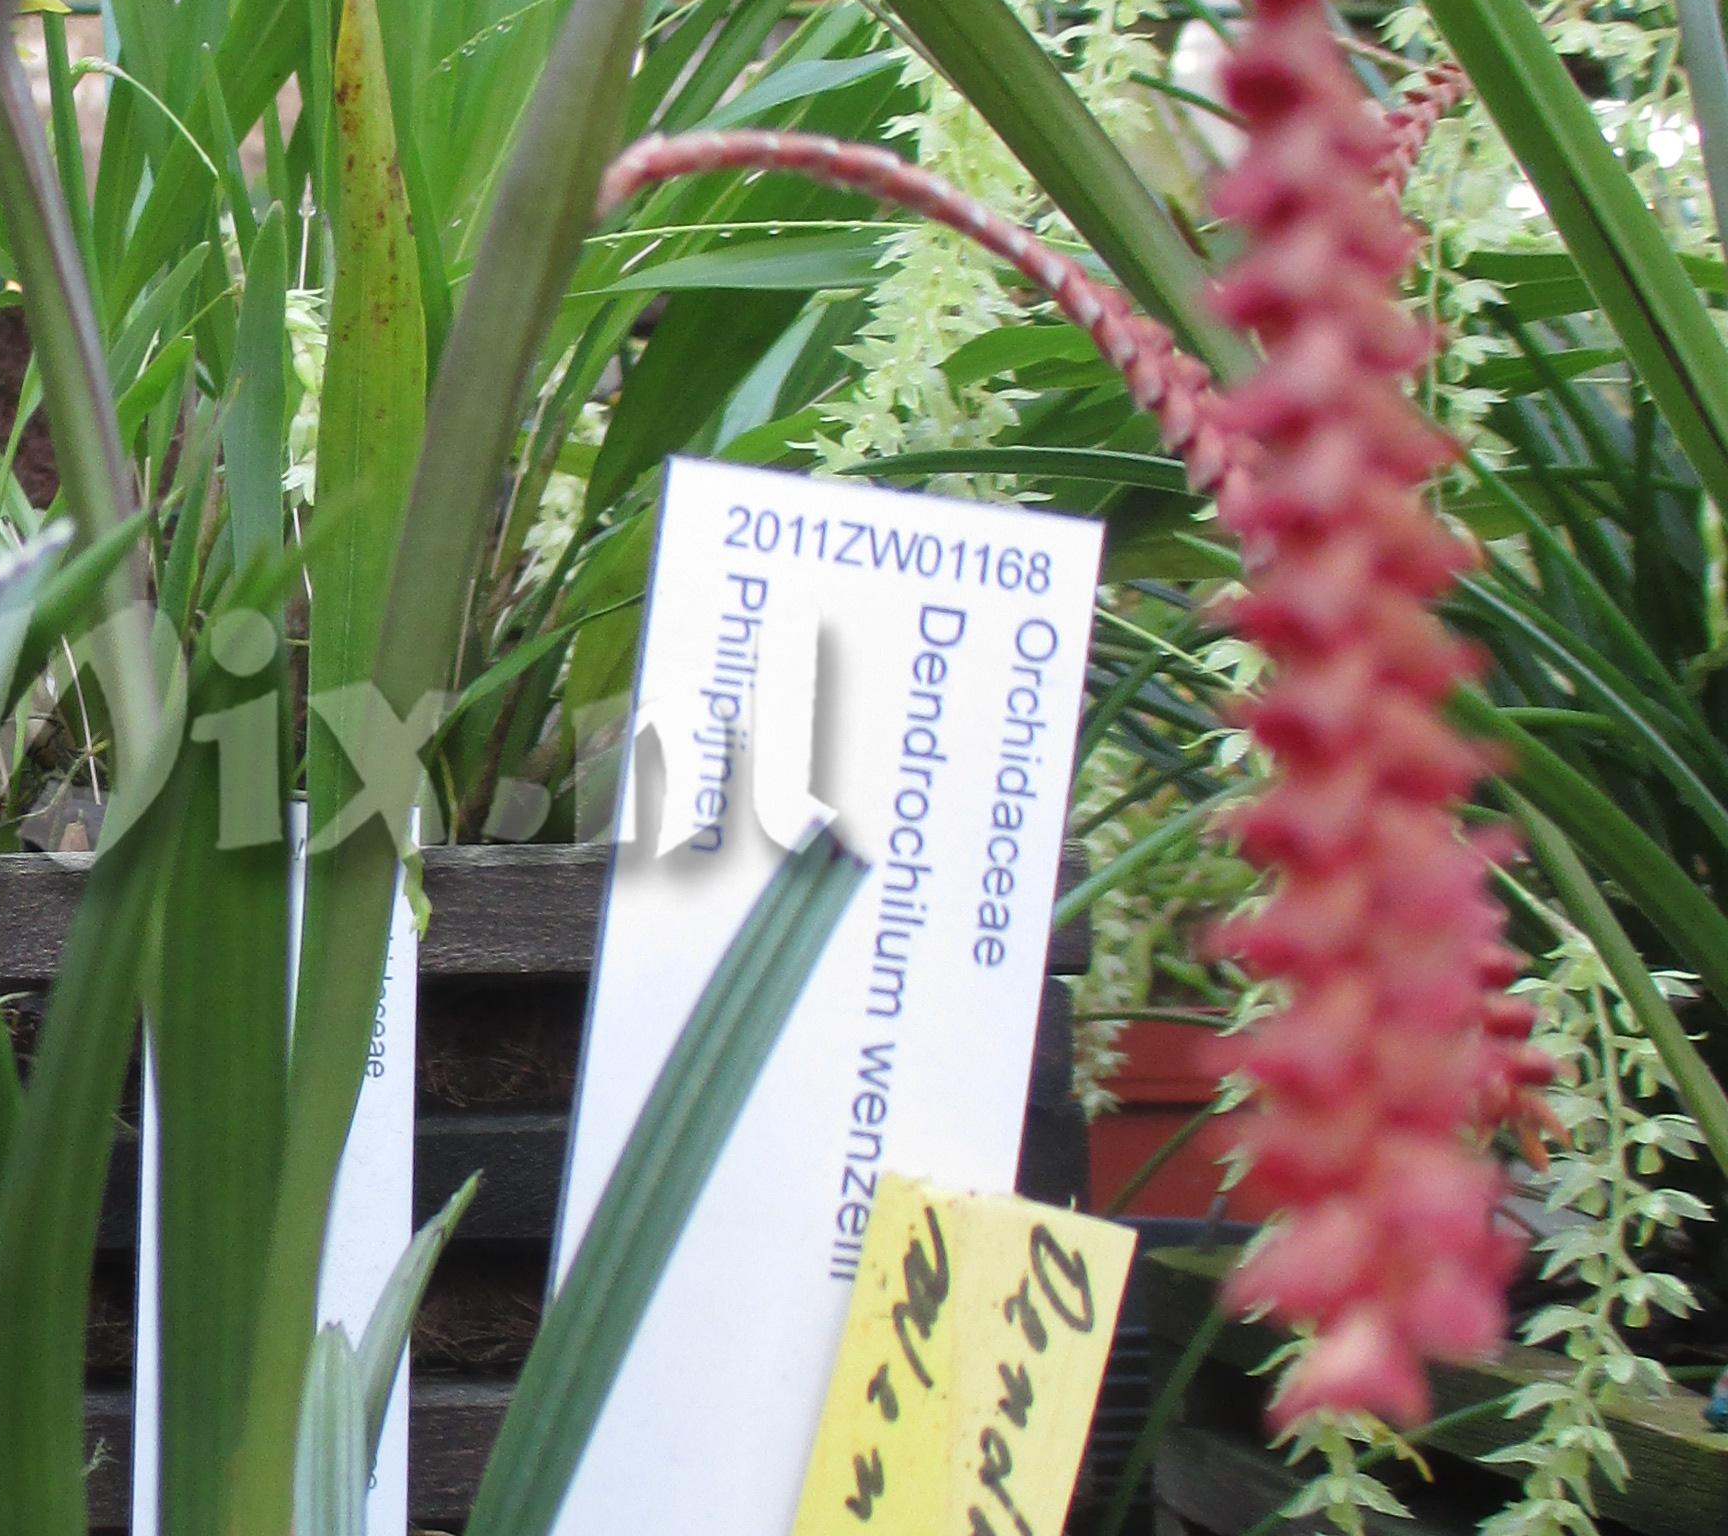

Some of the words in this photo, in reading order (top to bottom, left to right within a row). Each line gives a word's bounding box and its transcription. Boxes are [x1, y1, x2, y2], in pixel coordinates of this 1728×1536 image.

[723, 505, 1053, 595] 2011ZW01168
[689, 571, 770, 856] Philipijnen
[866, 602, 967, 1018] Dendrochilum
[973, 617, 1060, 968] Orchidaceae
